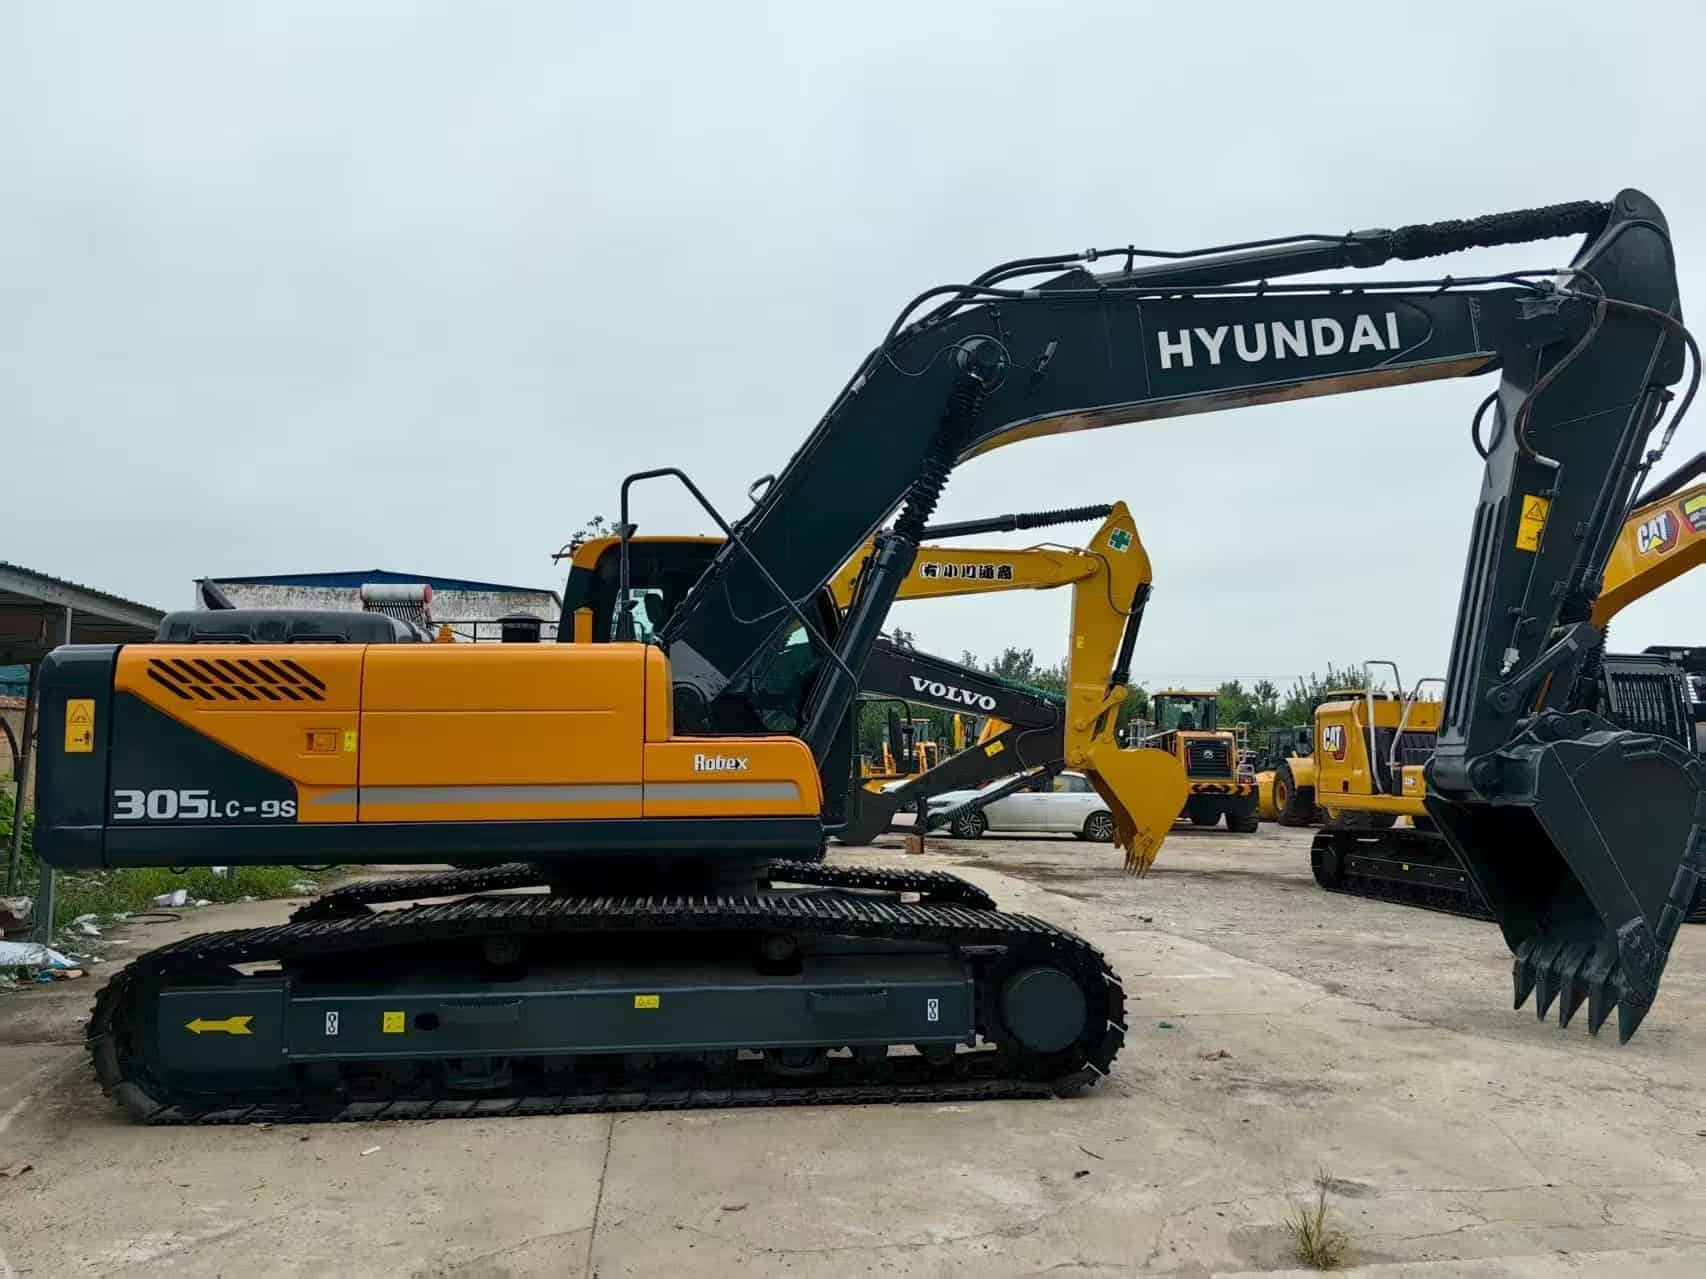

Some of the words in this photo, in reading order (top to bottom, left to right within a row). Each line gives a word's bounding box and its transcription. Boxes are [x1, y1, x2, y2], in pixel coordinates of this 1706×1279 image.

[1157, 312, 1401, 369] HYUNDAI
[1637, 512, 1667, 553] CAT
[910, 675, 996, 710] VOLVO
[1323, 726, 1341, 751] CAT
[694, 754, 748, 772] Robex
